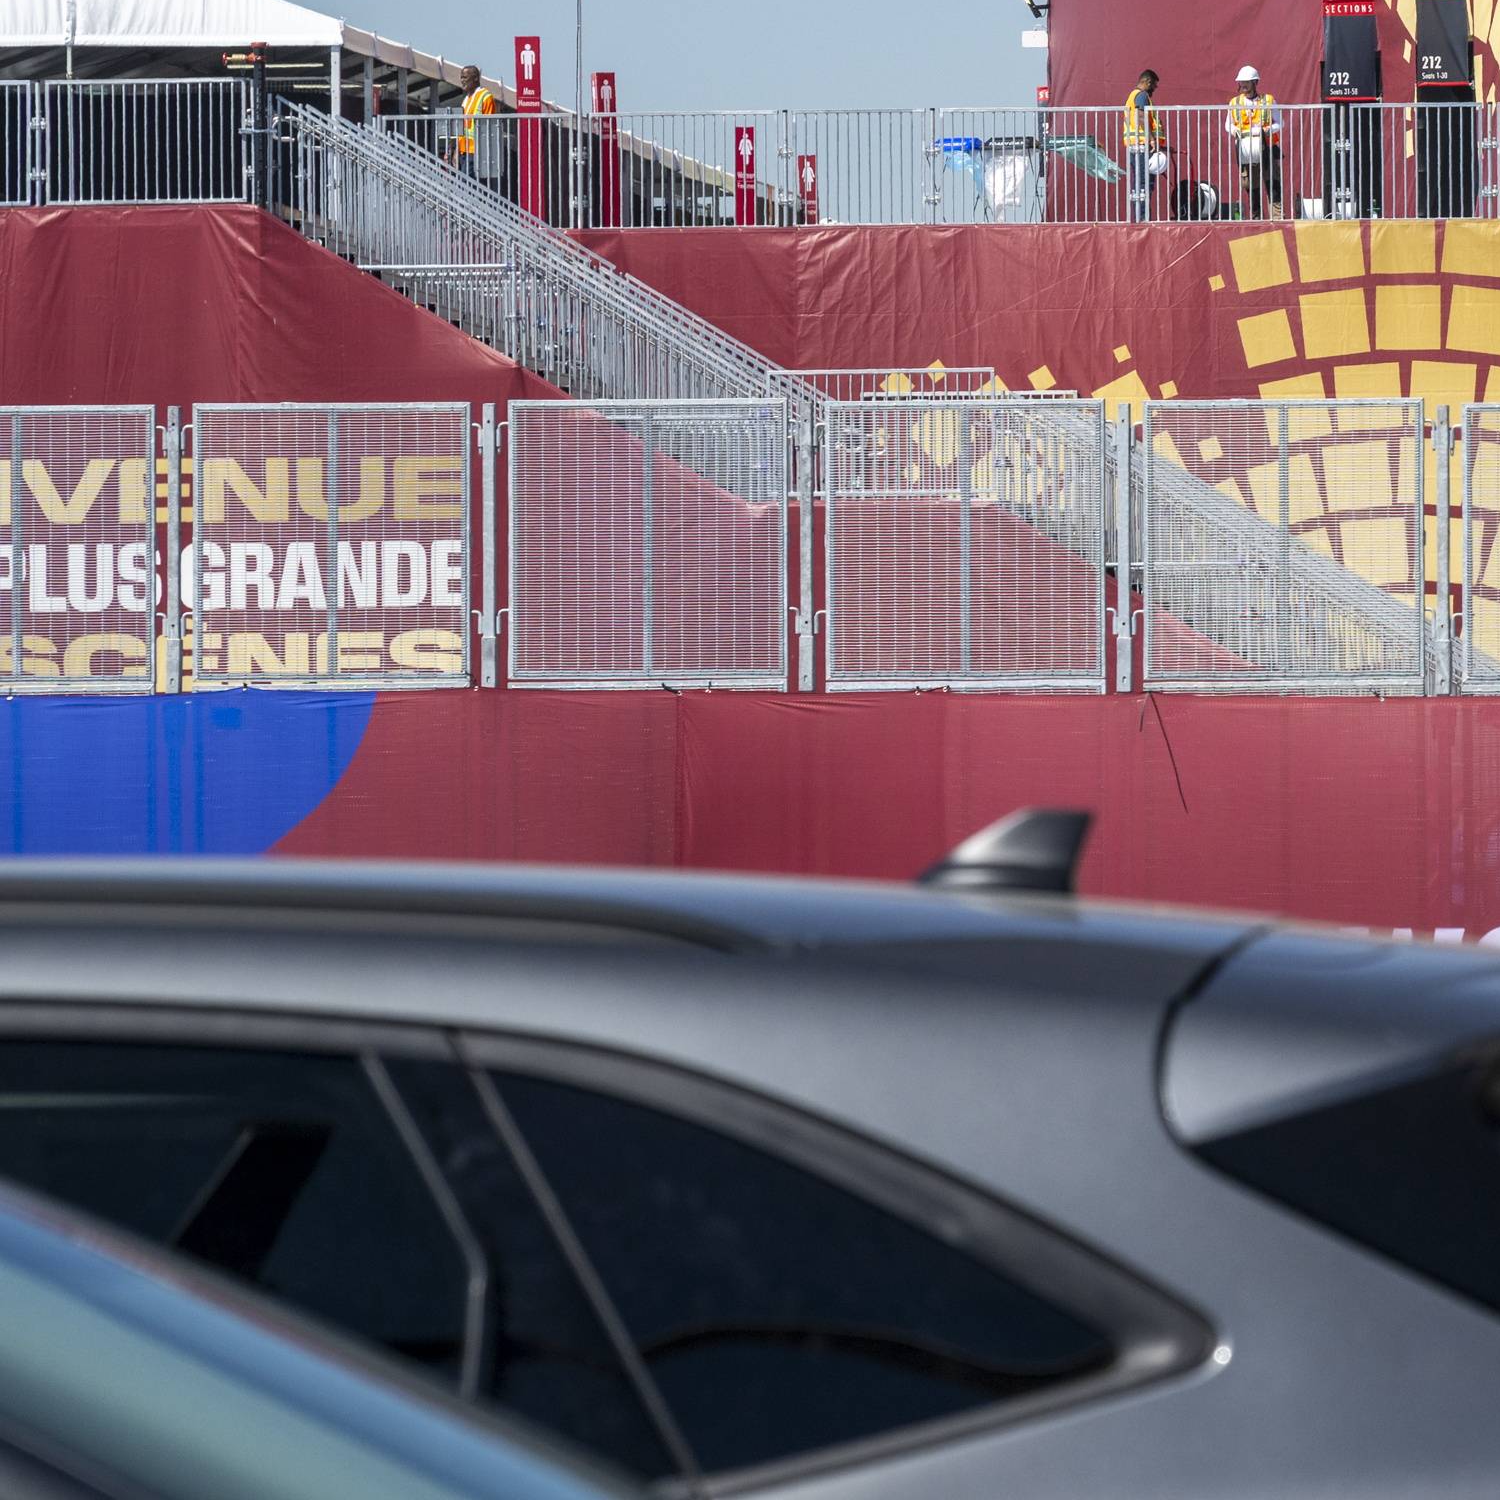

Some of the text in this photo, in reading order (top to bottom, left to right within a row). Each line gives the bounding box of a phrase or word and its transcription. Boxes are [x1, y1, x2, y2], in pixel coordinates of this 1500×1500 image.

[1325, 3, 1373, 14] SECTIONS
[1421, 56, 1442, 70] 212
[1329, 72, 1350, 85] 212
[0, 457, 463, 525] VENUE
[181, 540, 462, 610] GRANDE
